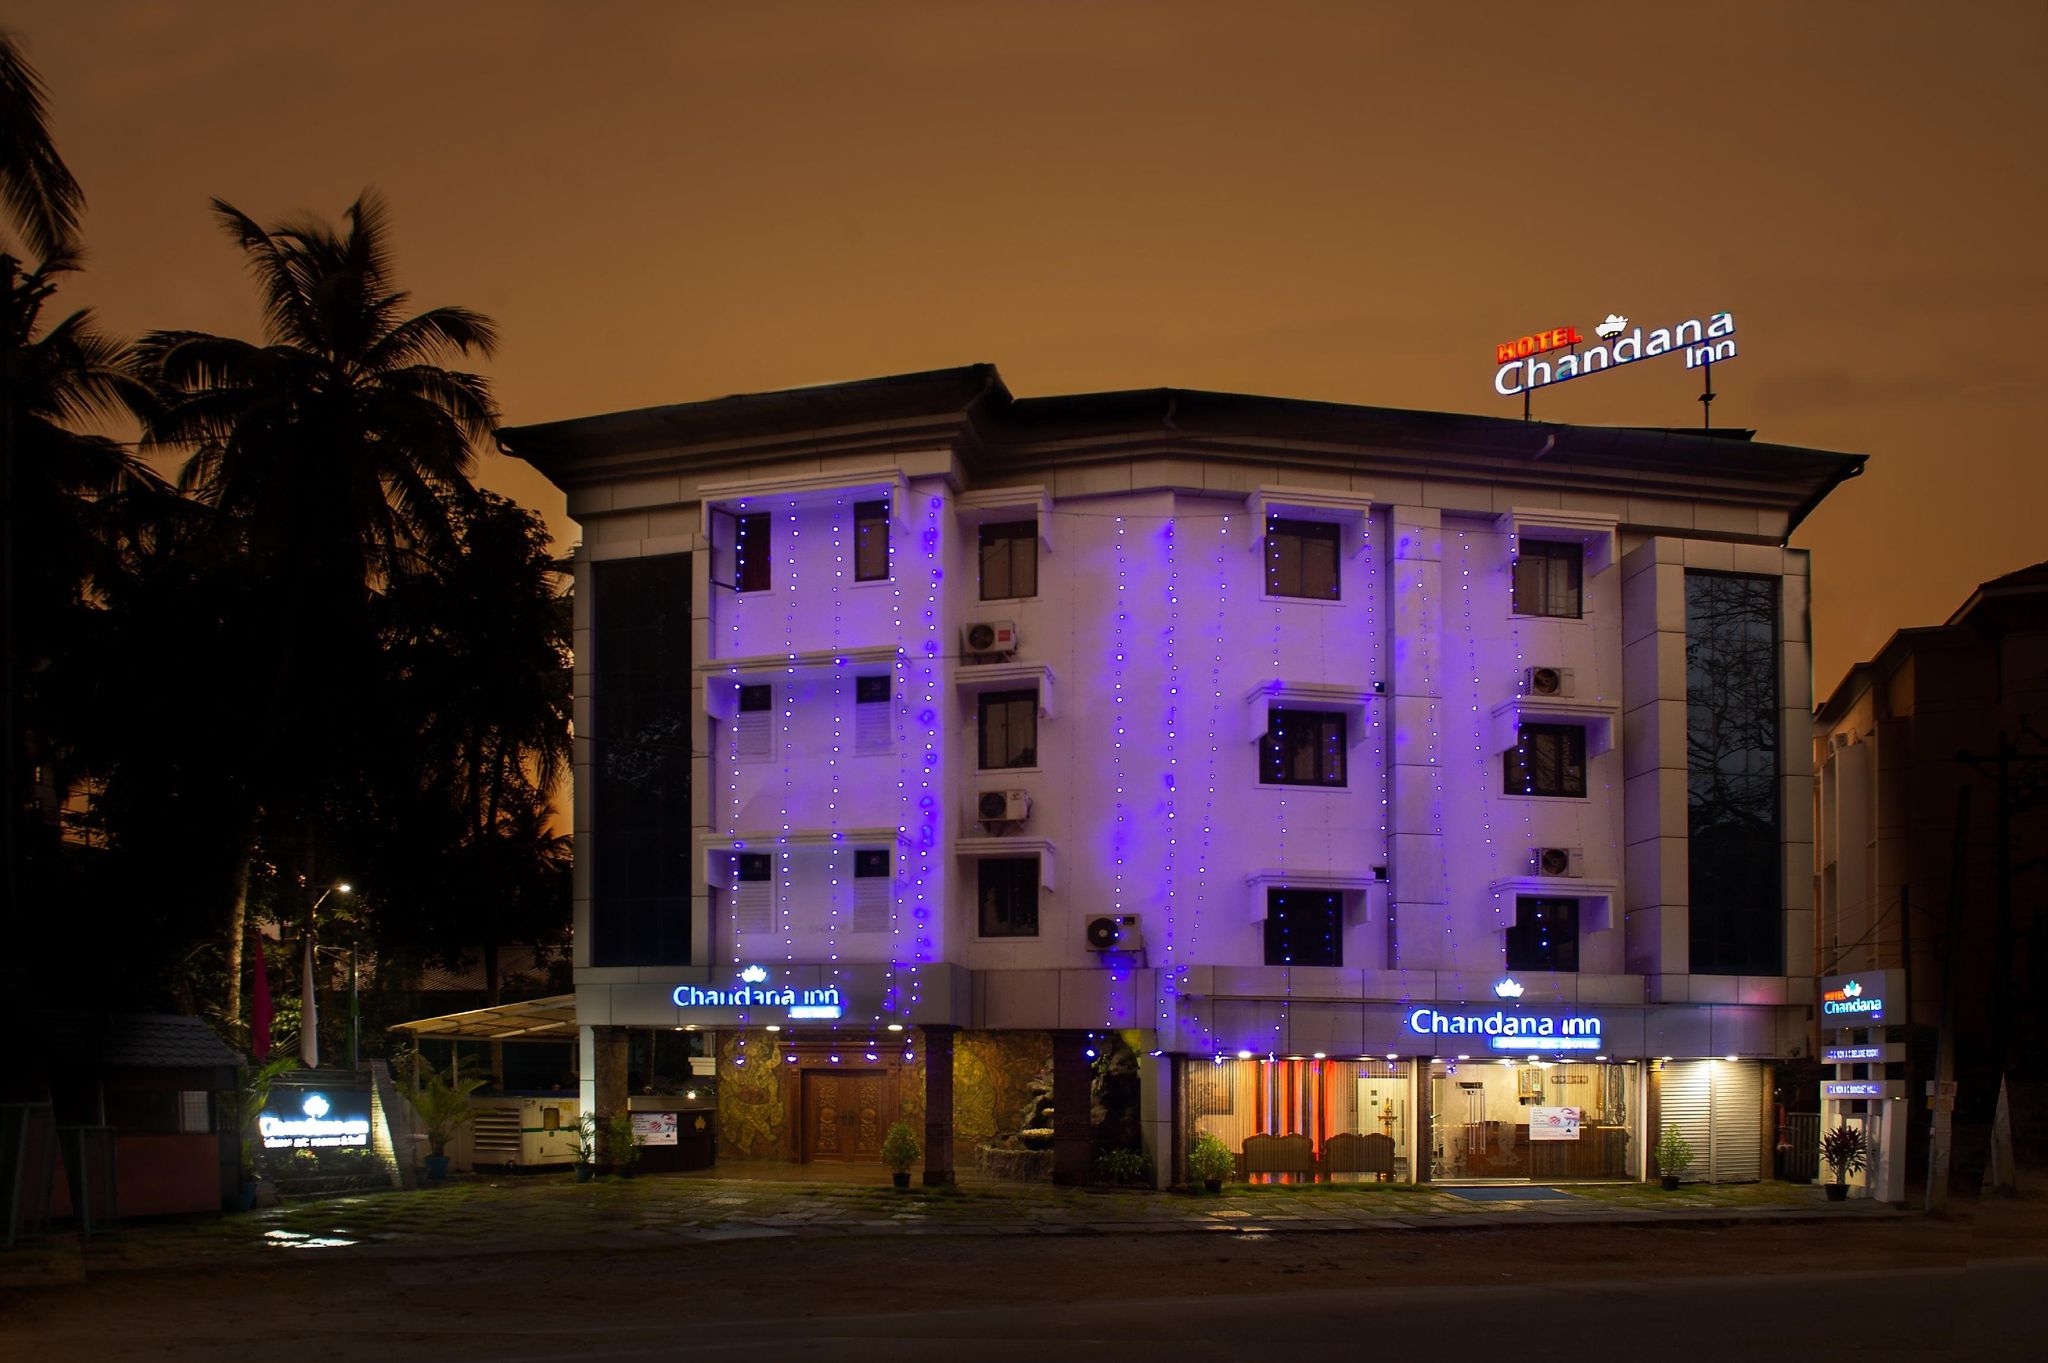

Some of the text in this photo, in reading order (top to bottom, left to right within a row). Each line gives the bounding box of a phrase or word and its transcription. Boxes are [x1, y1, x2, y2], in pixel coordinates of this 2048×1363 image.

[1494, 312, 1736, 396] Chandana
[1497, 327, 1583, 364] HOTEL
[1410, 1009, 1554, 1036] Chandana
[1824, 998, 1882, 1015] Chandana
